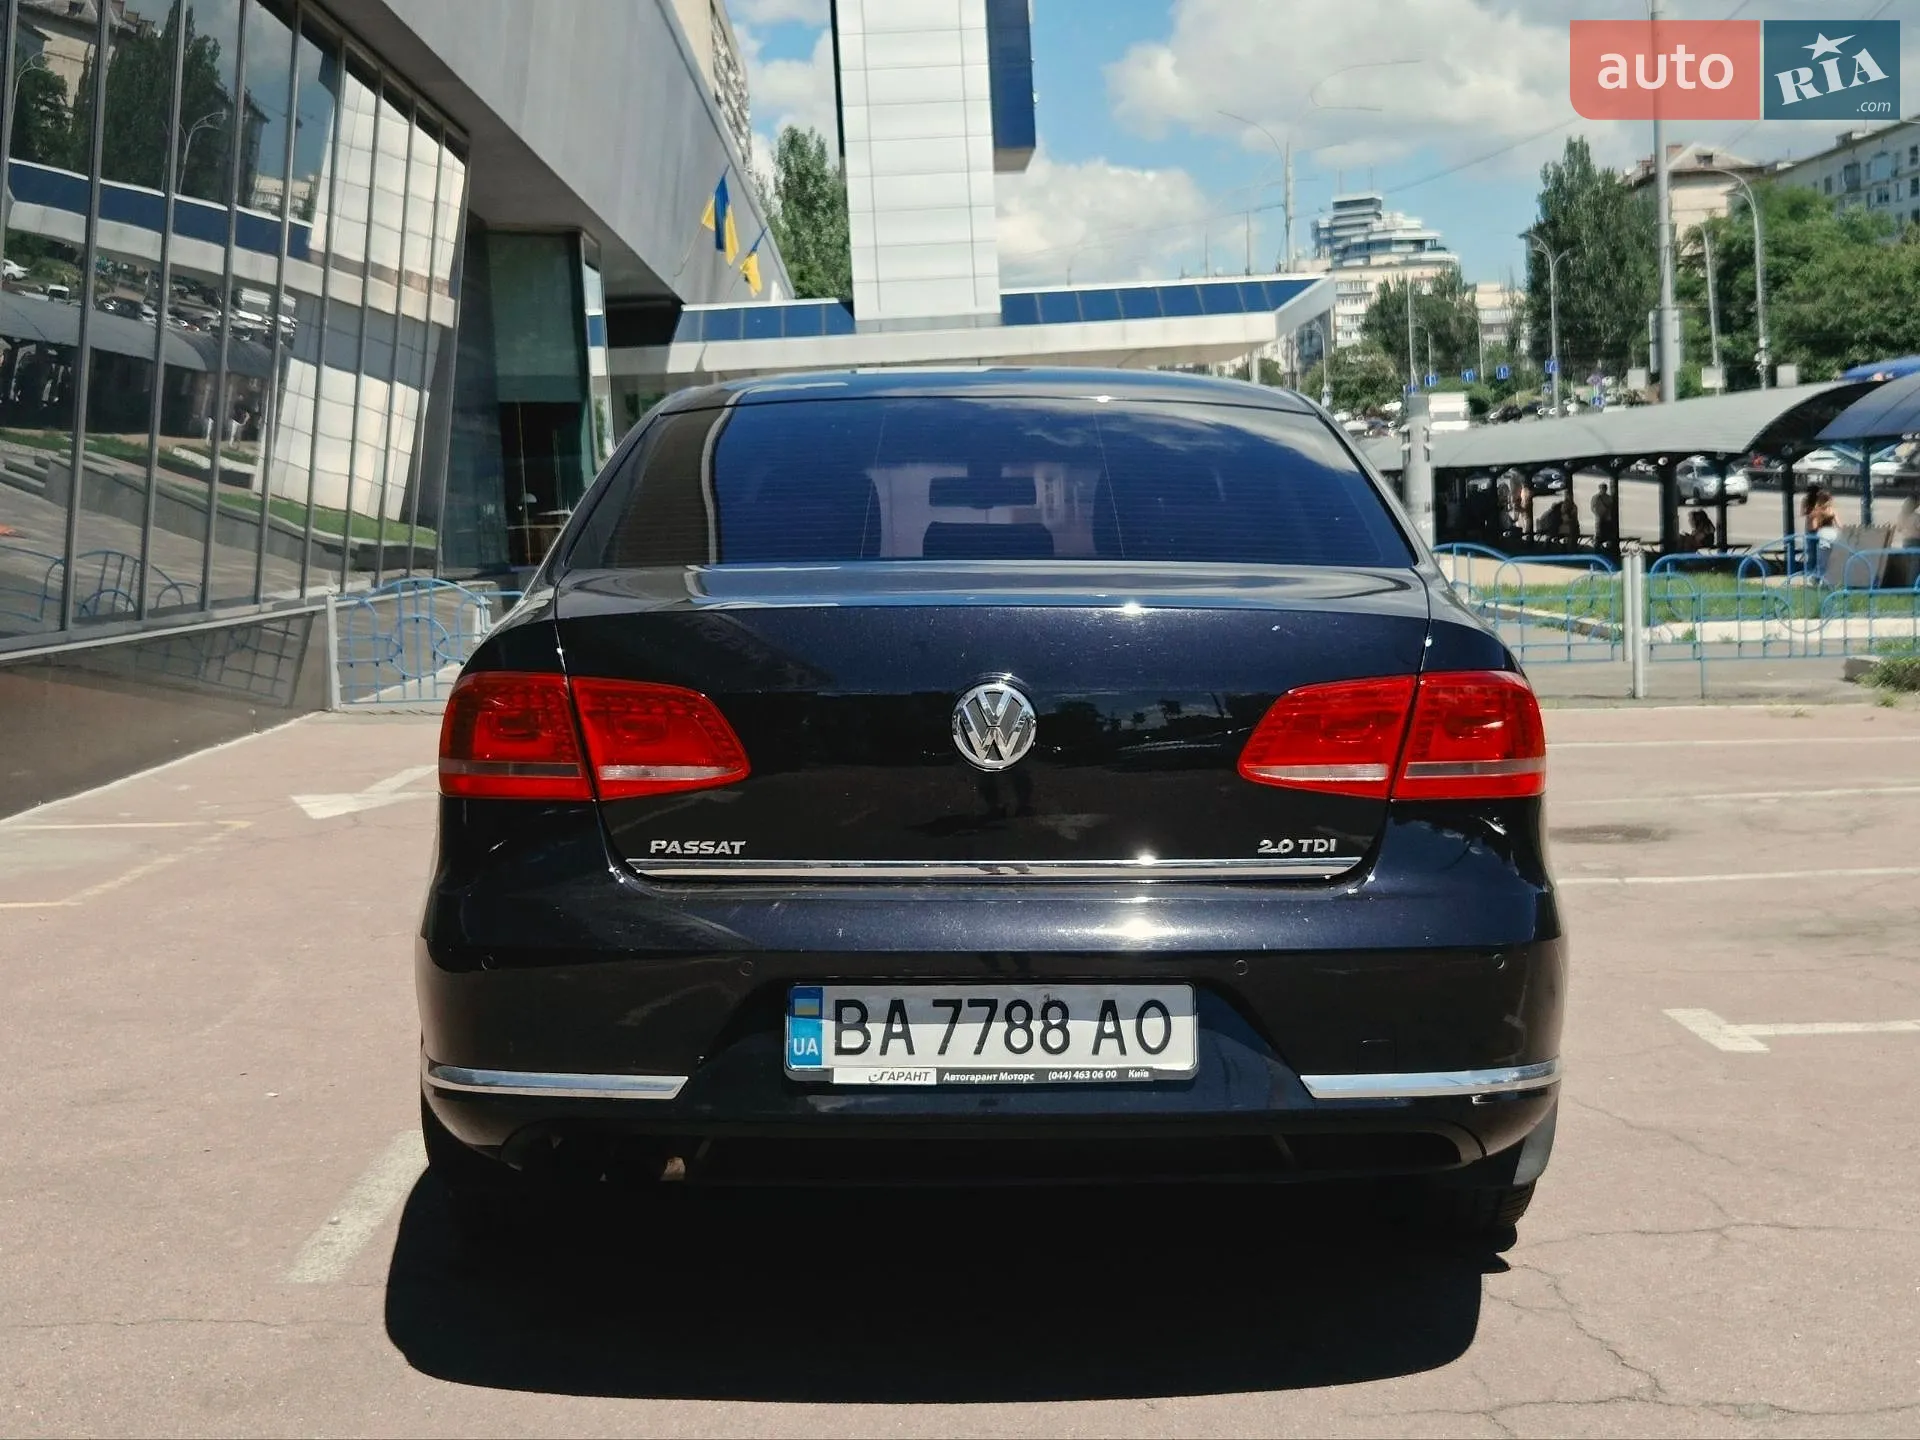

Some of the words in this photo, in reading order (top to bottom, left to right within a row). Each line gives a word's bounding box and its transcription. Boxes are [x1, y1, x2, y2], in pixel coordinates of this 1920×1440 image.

[649, 840, 747, 855] PASSAT
[1298, 838, 1337, 853] TDI
[833, 999, 915, 1056] BA
[932, 998, 1071, 1056] 7788
[1091, 999, 1172, 1056] AO
[793, 1037, 820, 1056] UA
[879, 1071, 931, 1082] ГАРАНТ
[943, 1072, 998, 1084] Автогарант
[998, 1071, 1036, 1083] Моторс
[1048, 1070, 1072, 1081] (044)
[1073, 1069, 1090, 1079] 463
[1091, 1070, 1103, 1079] 06
[1104, 1069, 1117, 1079] 00
[1128, 1069, 1149, 1078] Київ
